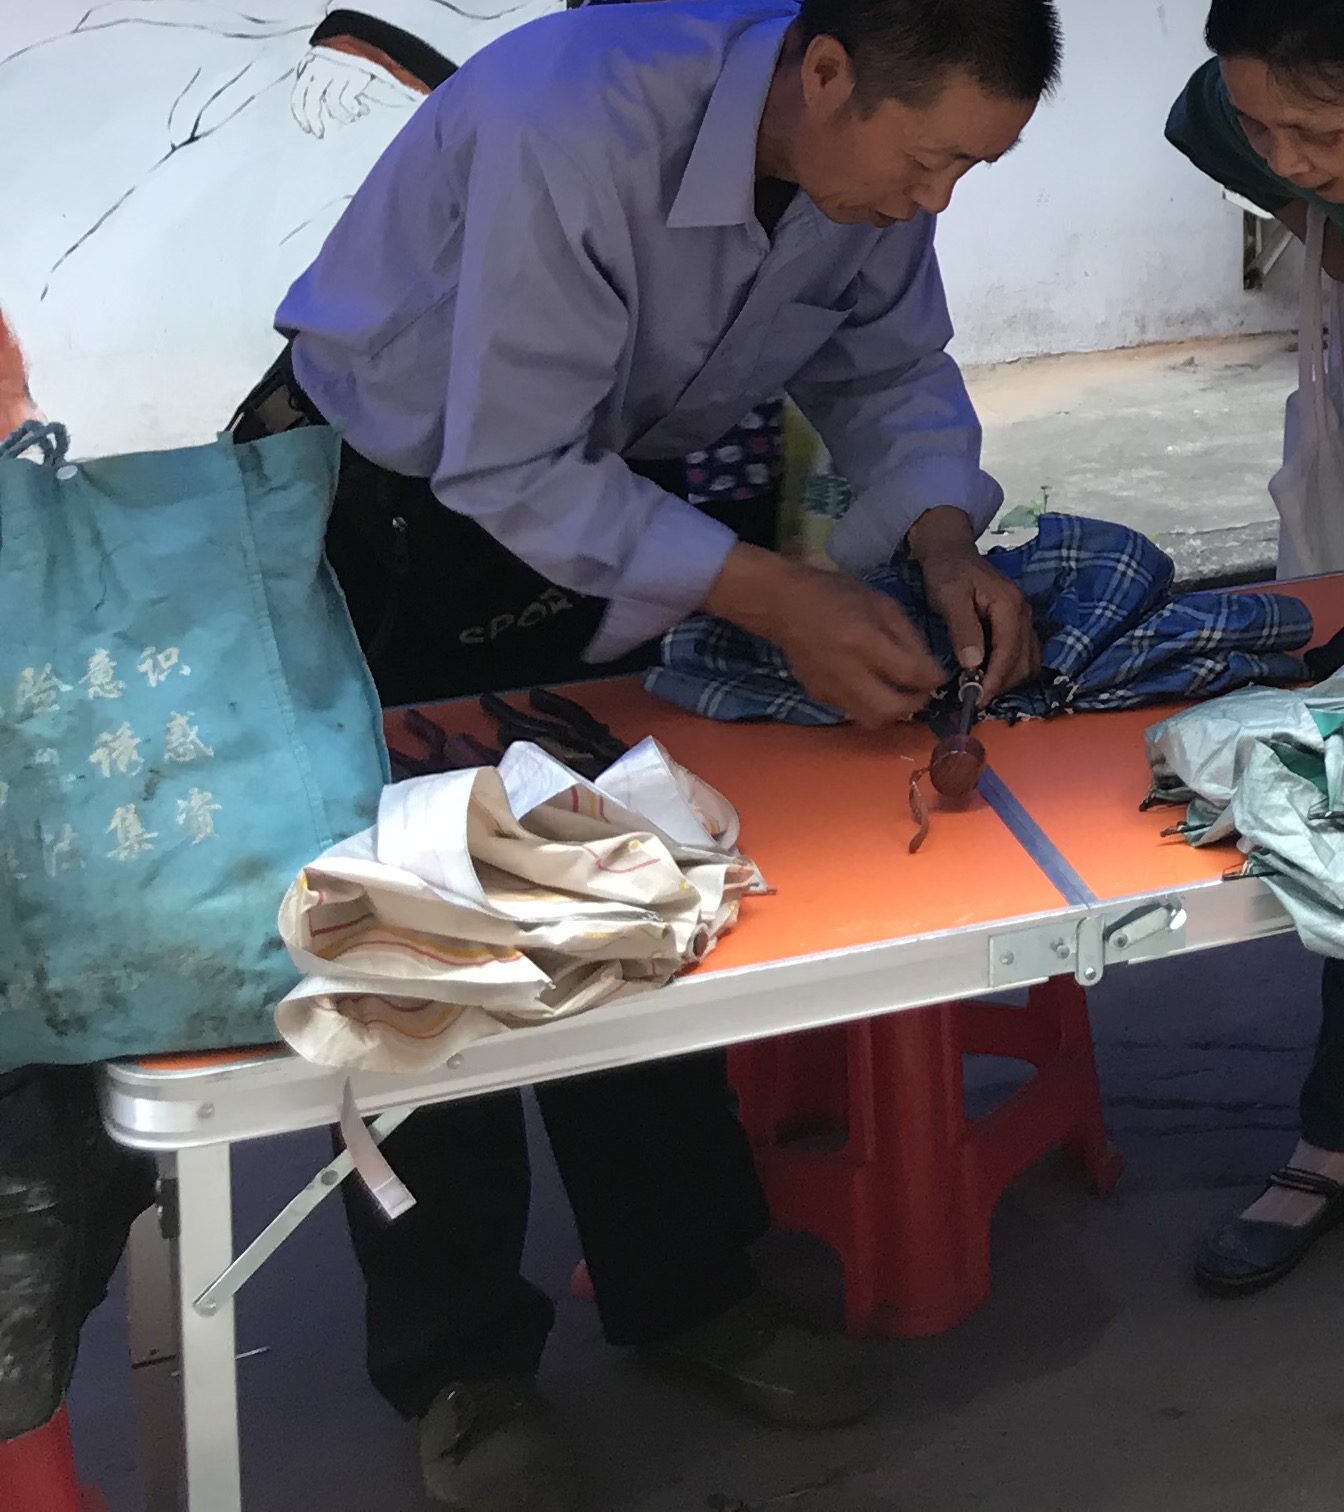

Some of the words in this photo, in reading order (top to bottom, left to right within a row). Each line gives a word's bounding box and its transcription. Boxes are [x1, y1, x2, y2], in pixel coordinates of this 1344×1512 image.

[458, 587, 584, 645] SPOR
[0, 646, 192, 714] 险意识
